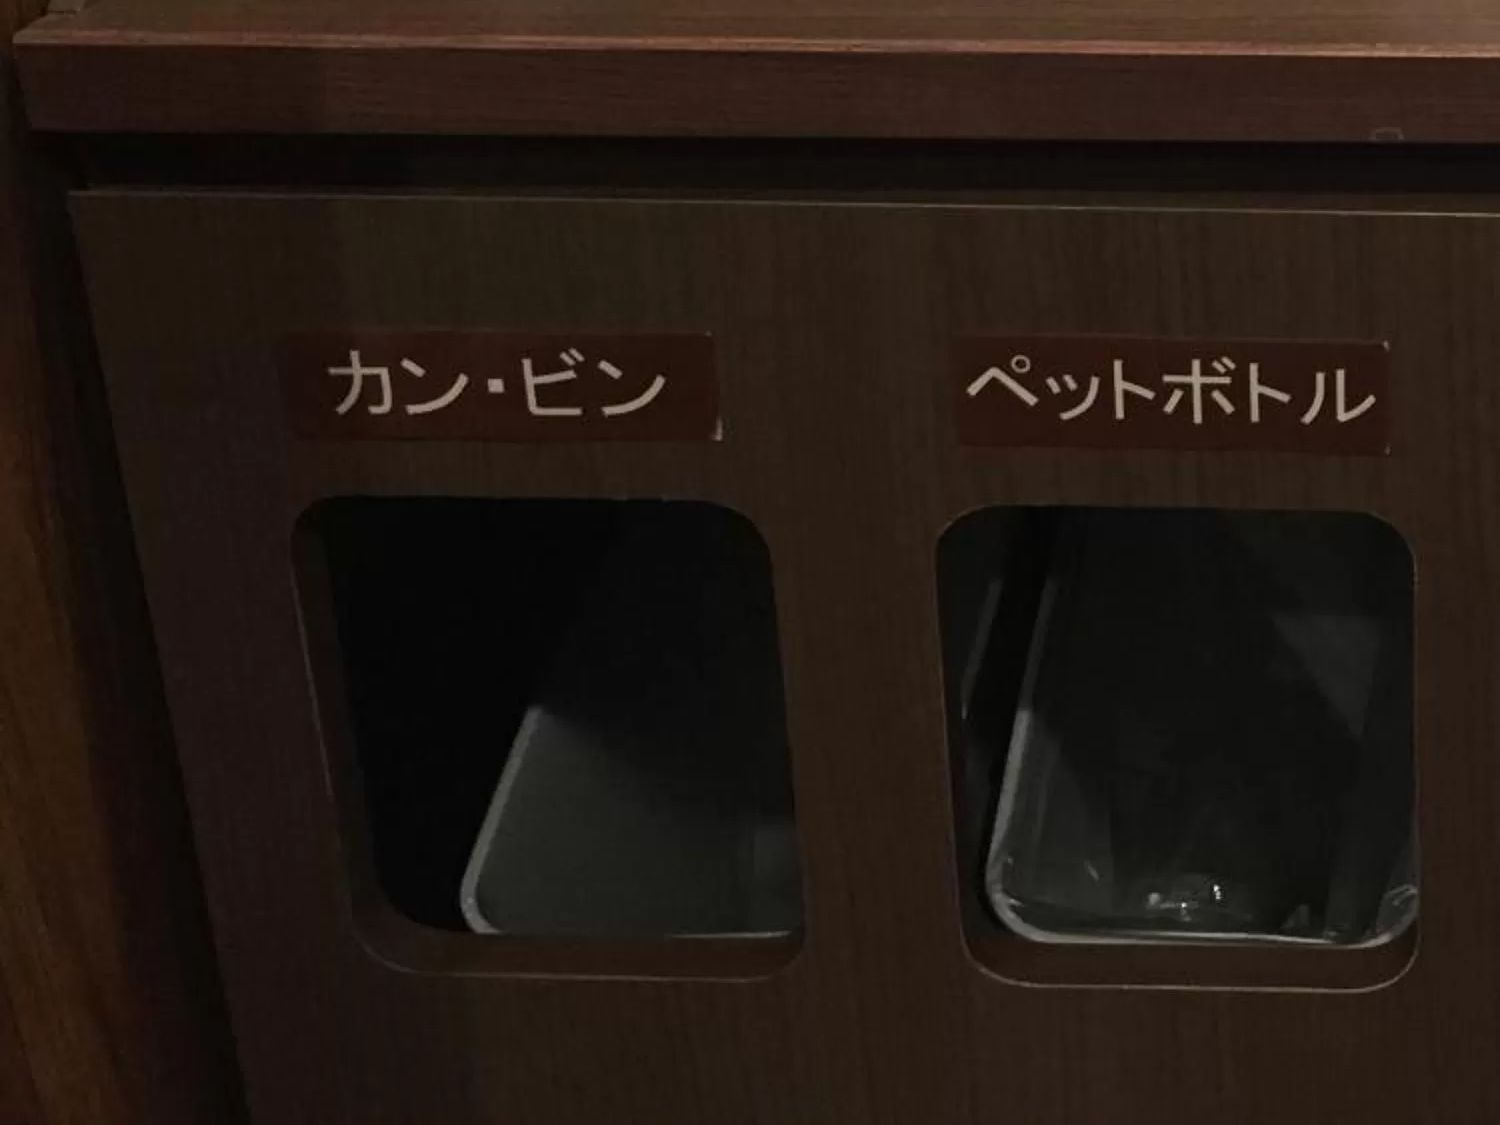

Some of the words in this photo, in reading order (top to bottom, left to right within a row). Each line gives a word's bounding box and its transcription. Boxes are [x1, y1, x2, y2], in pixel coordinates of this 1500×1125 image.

[328, 348, 666, 416] カン・ビン
[966, 354, 1377, 425] ペットボトル
